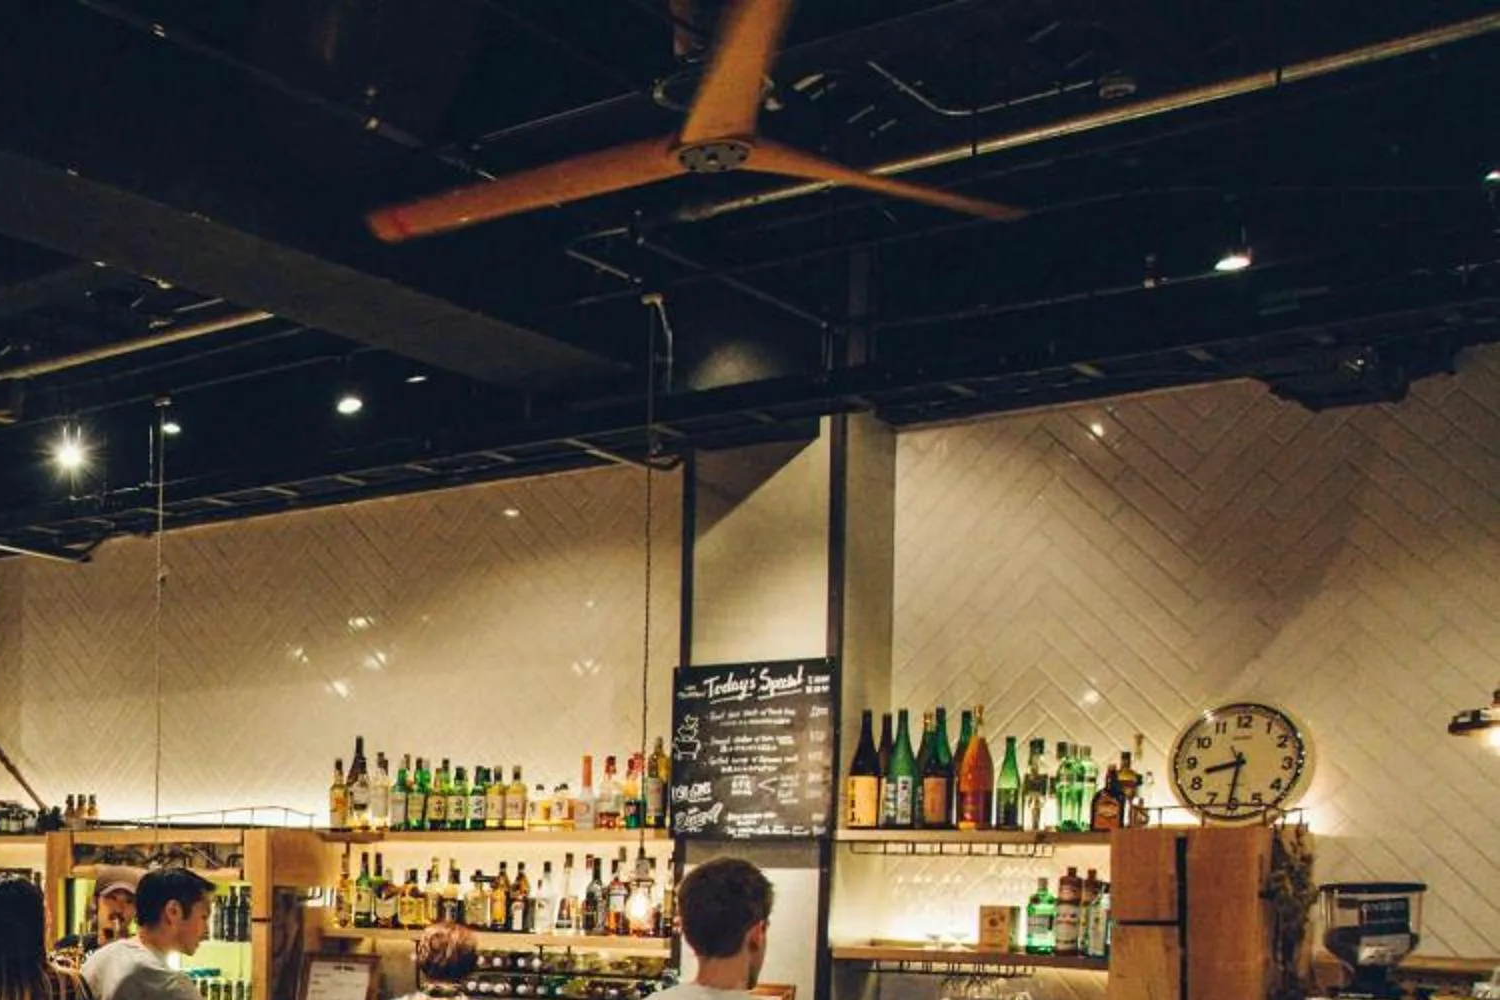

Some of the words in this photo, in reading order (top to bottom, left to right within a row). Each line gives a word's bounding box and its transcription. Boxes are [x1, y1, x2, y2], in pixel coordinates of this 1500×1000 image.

[703, 668, 756, 700] Today's
[1215, 721, 1227, 734] 11
[1236, 715, 1253, 729] 12
[1265, 721, 1272, 734] 1
[1196, 736, 1212, 749] 10
[1276, 736, 1288, 749] 2
[1187, 757, 1198, 770] 9
[1282, 757, 1293, 770] 3
[1191, 777, 1203, 790] 8
[1270, 778, 1282, 791] 4
[1206, 792, 1218, 806] 7
[1251, 792, 1262, 806] 5
